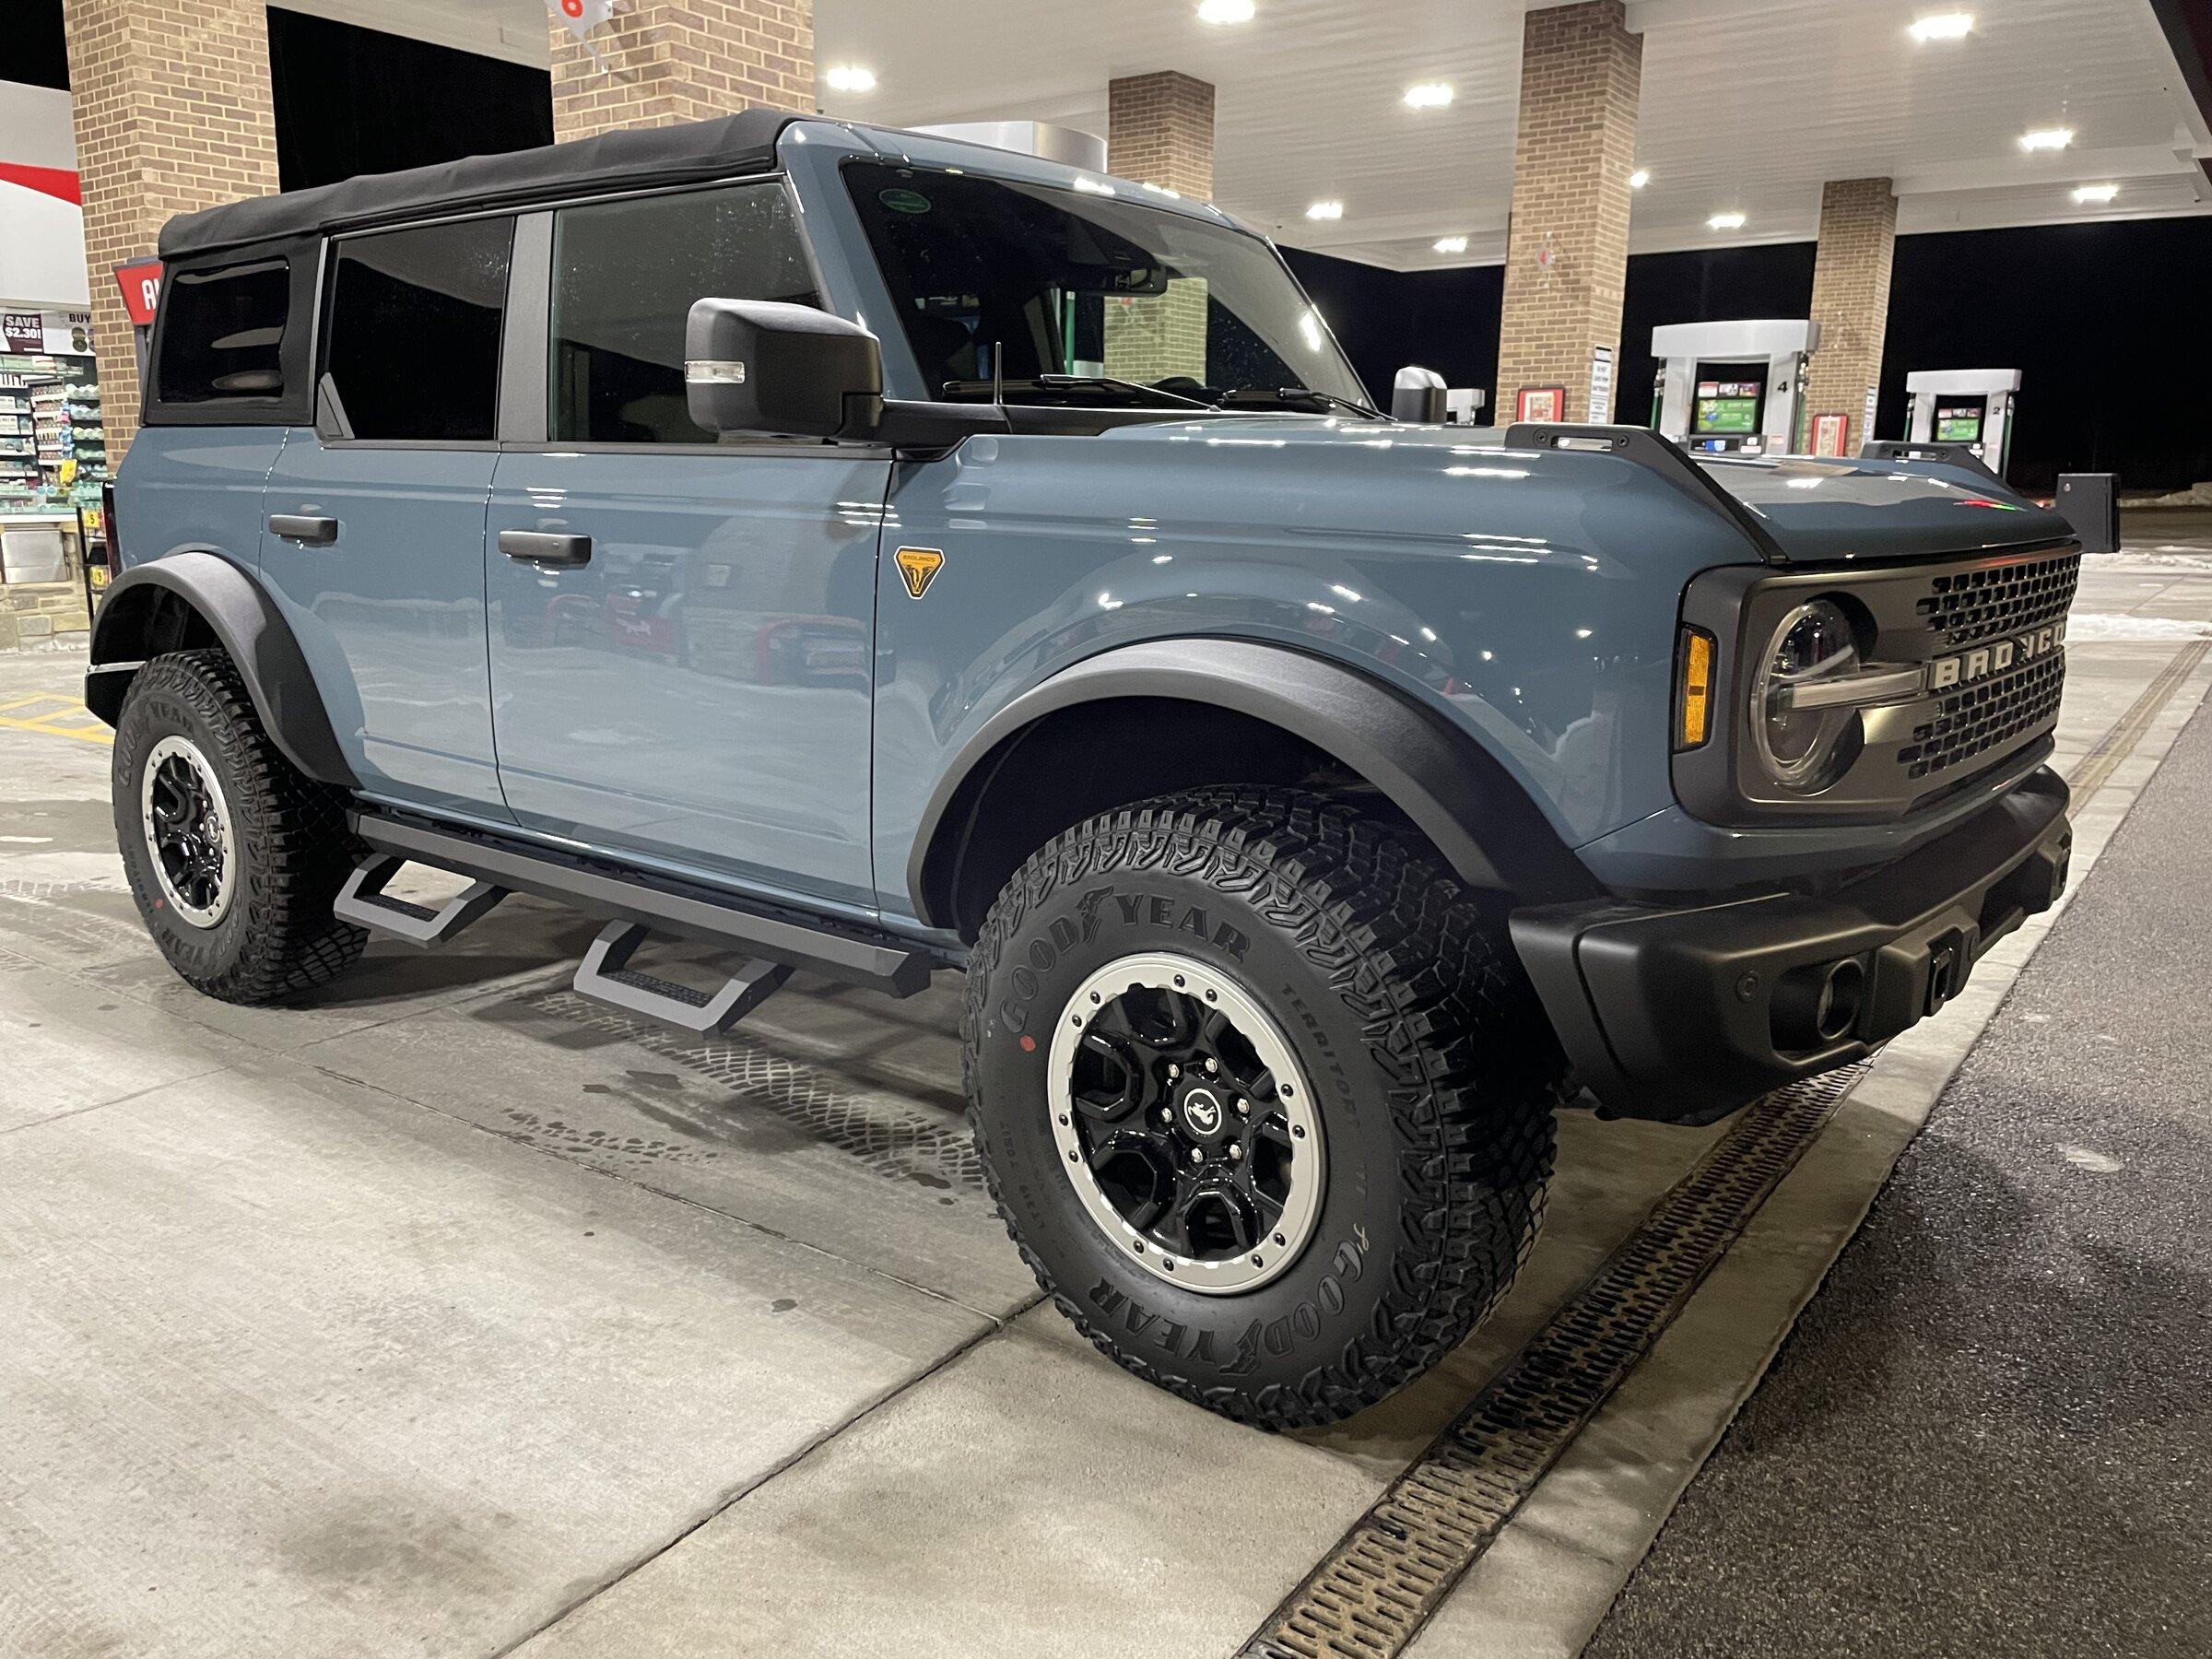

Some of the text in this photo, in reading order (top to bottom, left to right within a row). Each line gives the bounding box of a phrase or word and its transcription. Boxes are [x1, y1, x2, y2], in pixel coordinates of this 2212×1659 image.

[6, 315, 40, 328] SAVE
[69, 313, 91, 324] BUY
[5, 326, 41, 339] $2.30!
[1778, 381, 1788, 393] 4
[1993, 406, 2001, 415] 2
[1934, 621, 2065, 689] BRONCO
